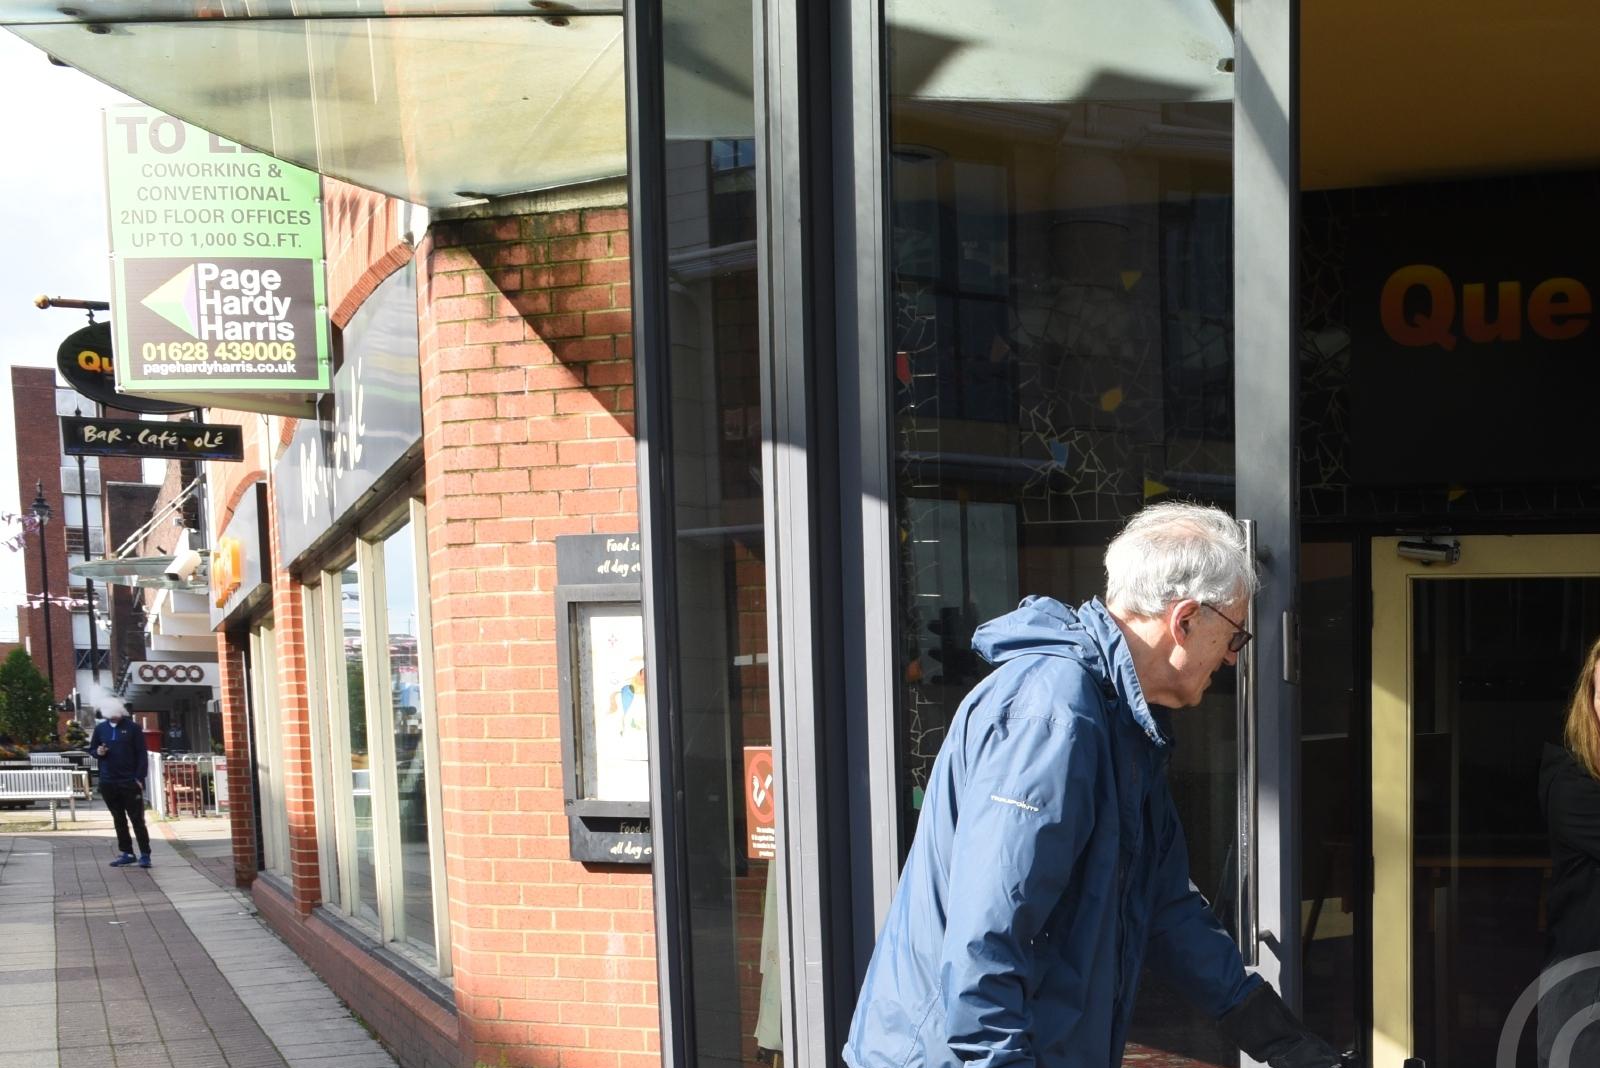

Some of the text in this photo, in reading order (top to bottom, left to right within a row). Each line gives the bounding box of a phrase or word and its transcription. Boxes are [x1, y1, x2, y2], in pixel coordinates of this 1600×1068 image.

[115, 115, 186, 154] TO
[141, 163, 282, 178] COWORKING &
[136, 185, 290, 202] CONVENTIONAL
[120, 209, 311, 225] 2ND FLOOR OFFICES
[190, 232, 237, 248] 1,000
[243, 233, 302, 247] SQ.FT.
[197, 263, 282, 295] Page
[199, 289, 291, 320] Hardy
[1380, 263, 1593, 351] Que
[199, 315, 295, 341] Harris
[142, 342, 296, 362] 01628 439006
[77, 350, 114, 373] Qu
[143, 360, 296, 375] pagehardyharris.co.uk
[606, 536, 630, 552] Food
[597, 559, 610, 574] all
[611, 558, 629, 577] day
[620, 821, 642, 834] Food
[610, 841, 624, 854] all
[624, 841, 643, 859] day
